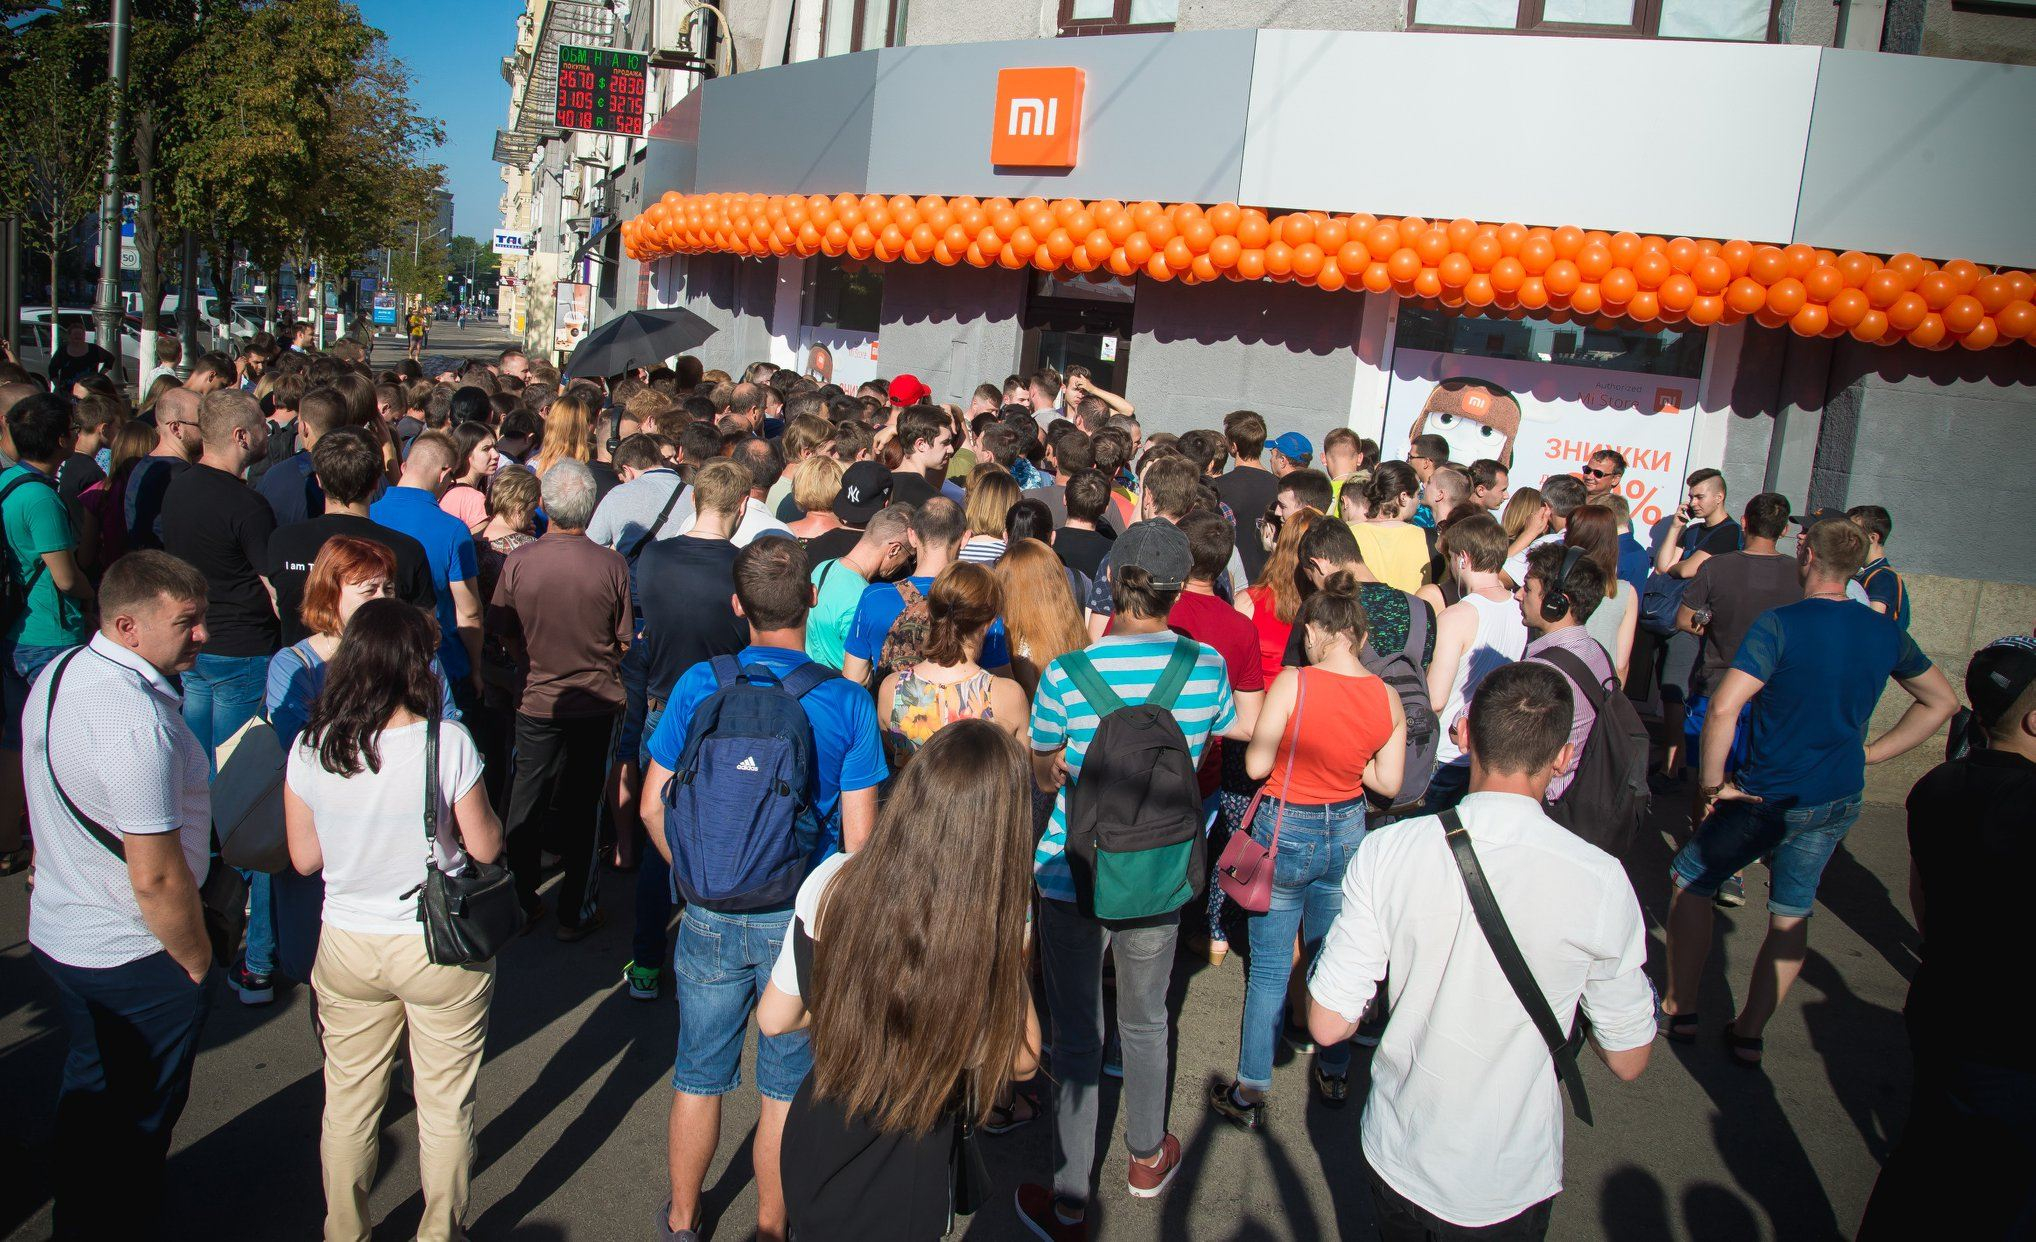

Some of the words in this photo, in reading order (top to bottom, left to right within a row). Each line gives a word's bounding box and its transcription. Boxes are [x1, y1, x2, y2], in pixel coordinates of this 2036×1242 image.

[563, 63, 590, 71] ПОКУПКА
[613, 69, 642, 77] ПРОДАЖА
[599, 77, 605, 89] $
[596, 117, 603, 127] R
[122, 253, 134, 263] 50
[1596, 382, 1642, 392] Authorized
[1600, 394, 1640, 410] Store
[291, 563, 305, 571] am
